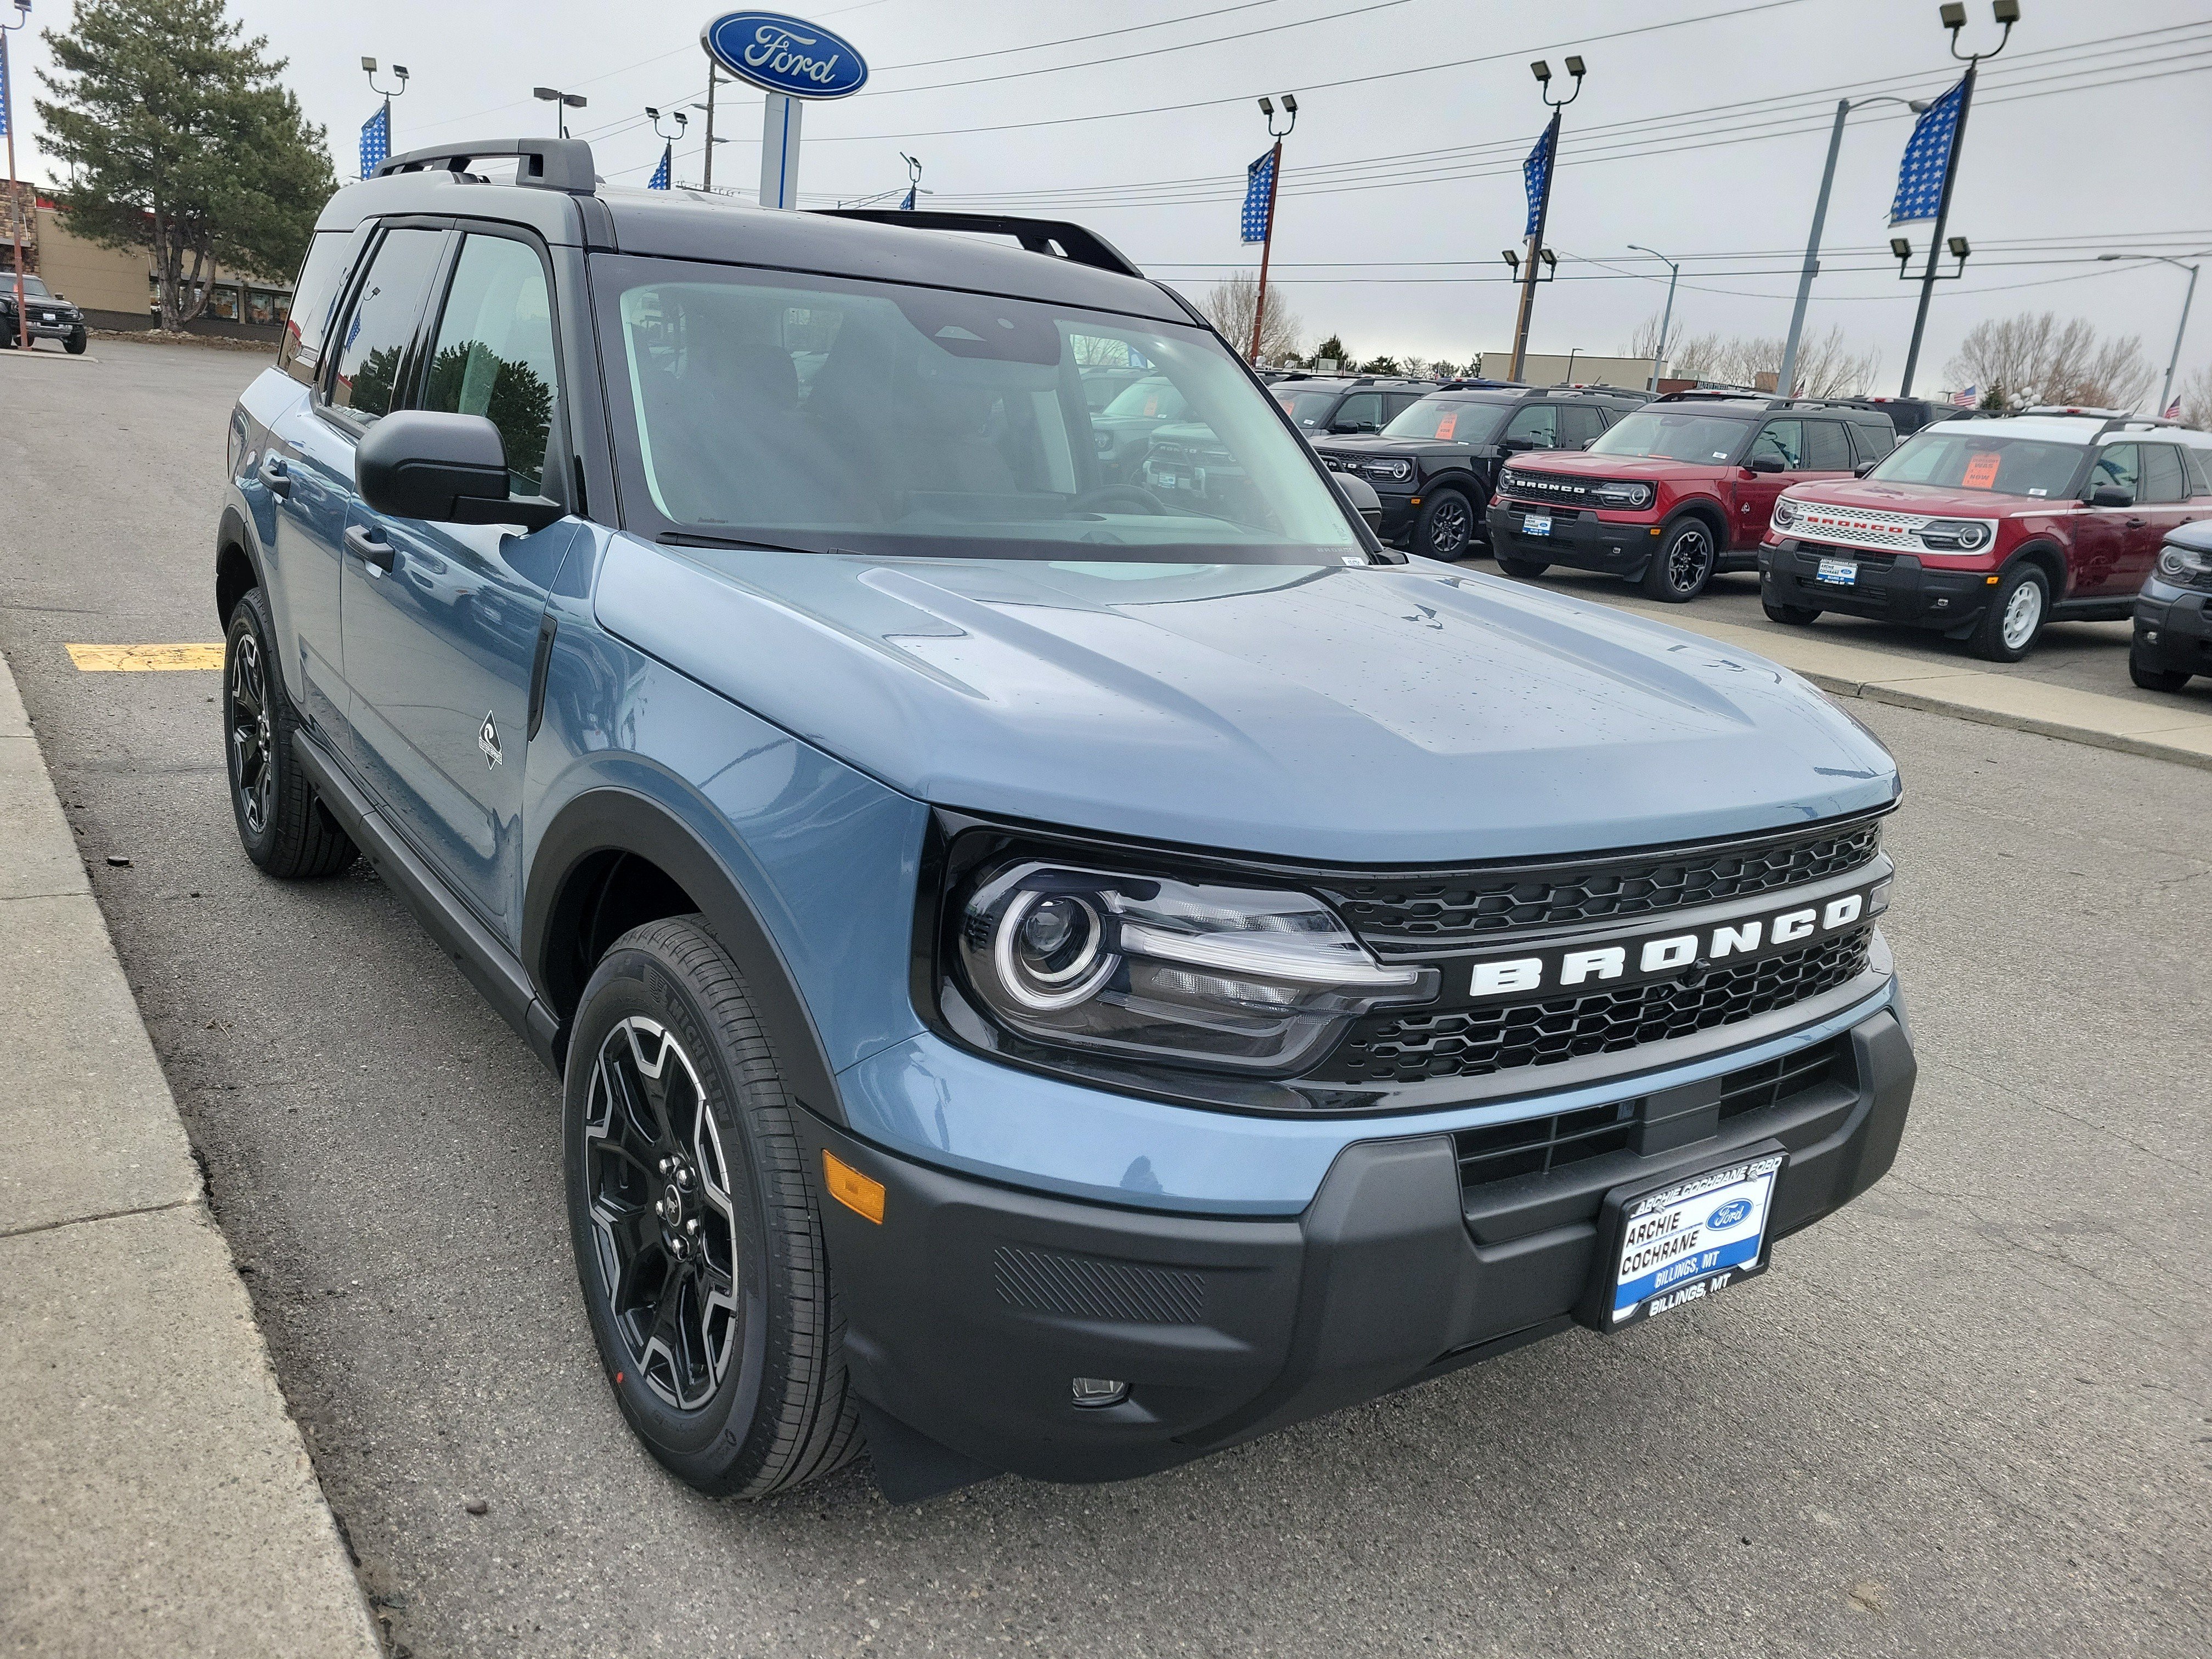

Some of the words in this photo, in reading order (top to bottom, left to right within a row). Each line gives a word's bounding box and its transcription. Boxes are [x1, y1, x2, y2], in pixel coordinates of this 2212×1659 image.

[744, 26, 839, 83] Ford
[1516, 481, 1585, 493] BRONCO
[1808, 517, 1903, 533] BRONCO
[479, 740, 490, 753] OUTER
[490, 748, 501, 761] BANKS
[1469, 894, 1863, 996] BRONCO
[669, 998, 730, 1121] MICHELIN
[1635, 1187, 1681, 1214] ARCHIE
[1681, 1166, 1748, 1197] COCHRANE
[1747, 1156, 1782, 1175] FORD
[1626, 1211, 1682, 1248] ARCHIE
[1714, 1203, 1745, 1227] Ford
[1622, 1230, 1700, 1276] COCHRANE
[1655, 1257, 1699, 1289] BILLINGS,
[1702, 1251, 1720, 1269] MT
[1649, 1282, 1707, 1317] BILLINGS,
[1710, 1273, 1731, 1293] MT
